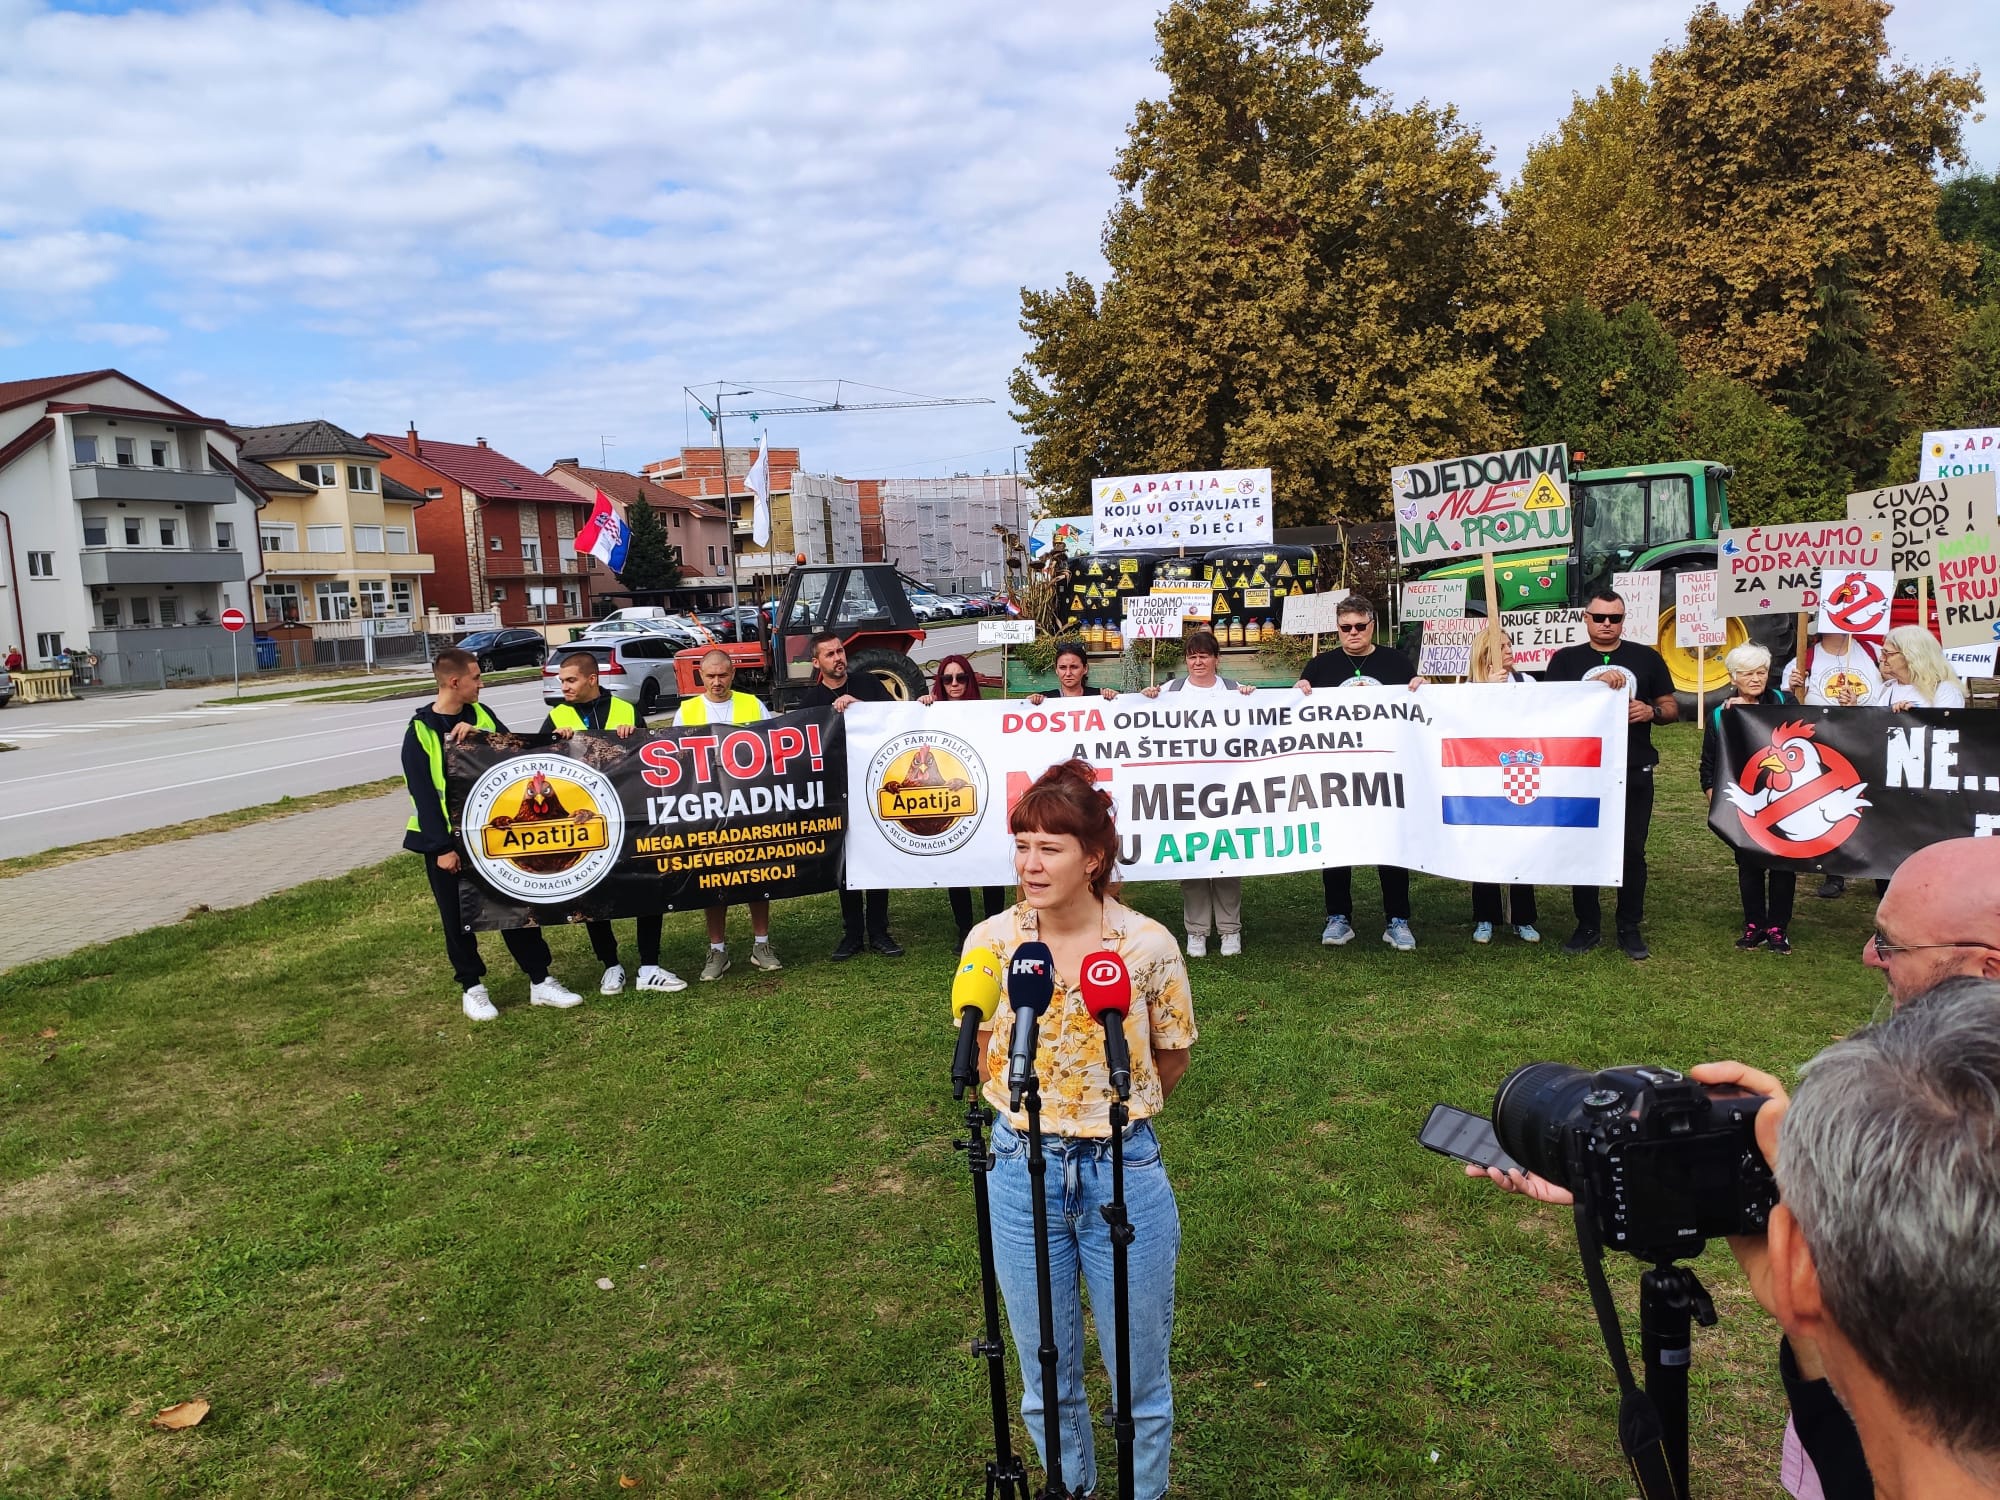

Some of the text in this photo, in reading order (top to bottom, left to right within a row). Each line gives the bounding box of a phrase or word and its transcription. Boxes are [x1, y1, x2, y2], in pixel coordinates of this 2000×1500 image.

[1965, 436, 2000, 451] AP
[1402, 445, 1568, 500] DJEDOVINA
[1132, 478, 1219, 493] APATIJA
[1873, 482, 1949, 510] ČUVAJ
[1105, 497, 1261, 517] KOJU VI OSTAVLJATE
[1436, 480, 1530, 522] NIJE
[1114, 522, 1243, 538] NAŠOJ DJECI
[1400, 507, 1571, 557] NA PRODAJU
[1746, 526, 1863, 553] ČUVAJMO
[1732, 548, 1878, 576] PODRAVINU
[1939, 554, 2000, 583] KUPU
[1443, 584, 1463, 593] NAM
[1691, 582, 1710, 593] NAM
[1734, 566, 1822, 593] ZA NAŠ
[1939, 577, 2000, 604] TRUJ
[1144, 597, 1182, 608] HODAMO
[1405, 605, 1464, 618] BUDUĆNOST
[1418, 594, 1447, 605] UZETI
[1682, 592, 1716, 606] DJECU
[1132, 607, 1178, 617] UZDIGNUTE
[1135, 617, 1165, 625] GLAVE
[1501, 611, 1540, 627] DRUGE
[1545, 608, 1583, 625] DRŽAV
[1137, 624, 1146, 637] A
[1424, 619, 1436, 631] NE
[1534, 627, 1575, 645] ŽELE
[1698, 631, 1727, 644] BRIGA
[1421, 661, 1468, 675] SMRADU!
[1002, 701, 1433, 734] DOSTA ODLUKA U IME GRAĐANA,
[639, 724, 824, 788] STOP!
[876, 742, 901, 767] STOP
[904, 735, 938, 746] FARMI
[1072, 730, 1364, 760] A NA ŠTETU GRAĐANA!
[480, 762, 599, 801] STOP FARMI PILIĆA
[646, 780, 825, 825] IZGRADNJI
[893, 791, 961, 814] Apatija
[1131, 771, 1406, 822] MEGAFARMI
[503, 824, 589, 850] Apatija
[636, 816, 842, 853] MEGA PERADARSKIH FARMI
[889, 827, 907, 843] SELO
[949, 825, 969, 843] KOKA
[1118, 821, 1322, 866] U APATIJI!
[657, 839, 826, 873] U SJEVEROZAPADNOJ
[497, 867, 521, 885] SELO
[574, 860, 600, 882] KOKA
[699, 864, 796, 889] HRVATSKOJ!
[1013, 958, 1045, 975] HRT
